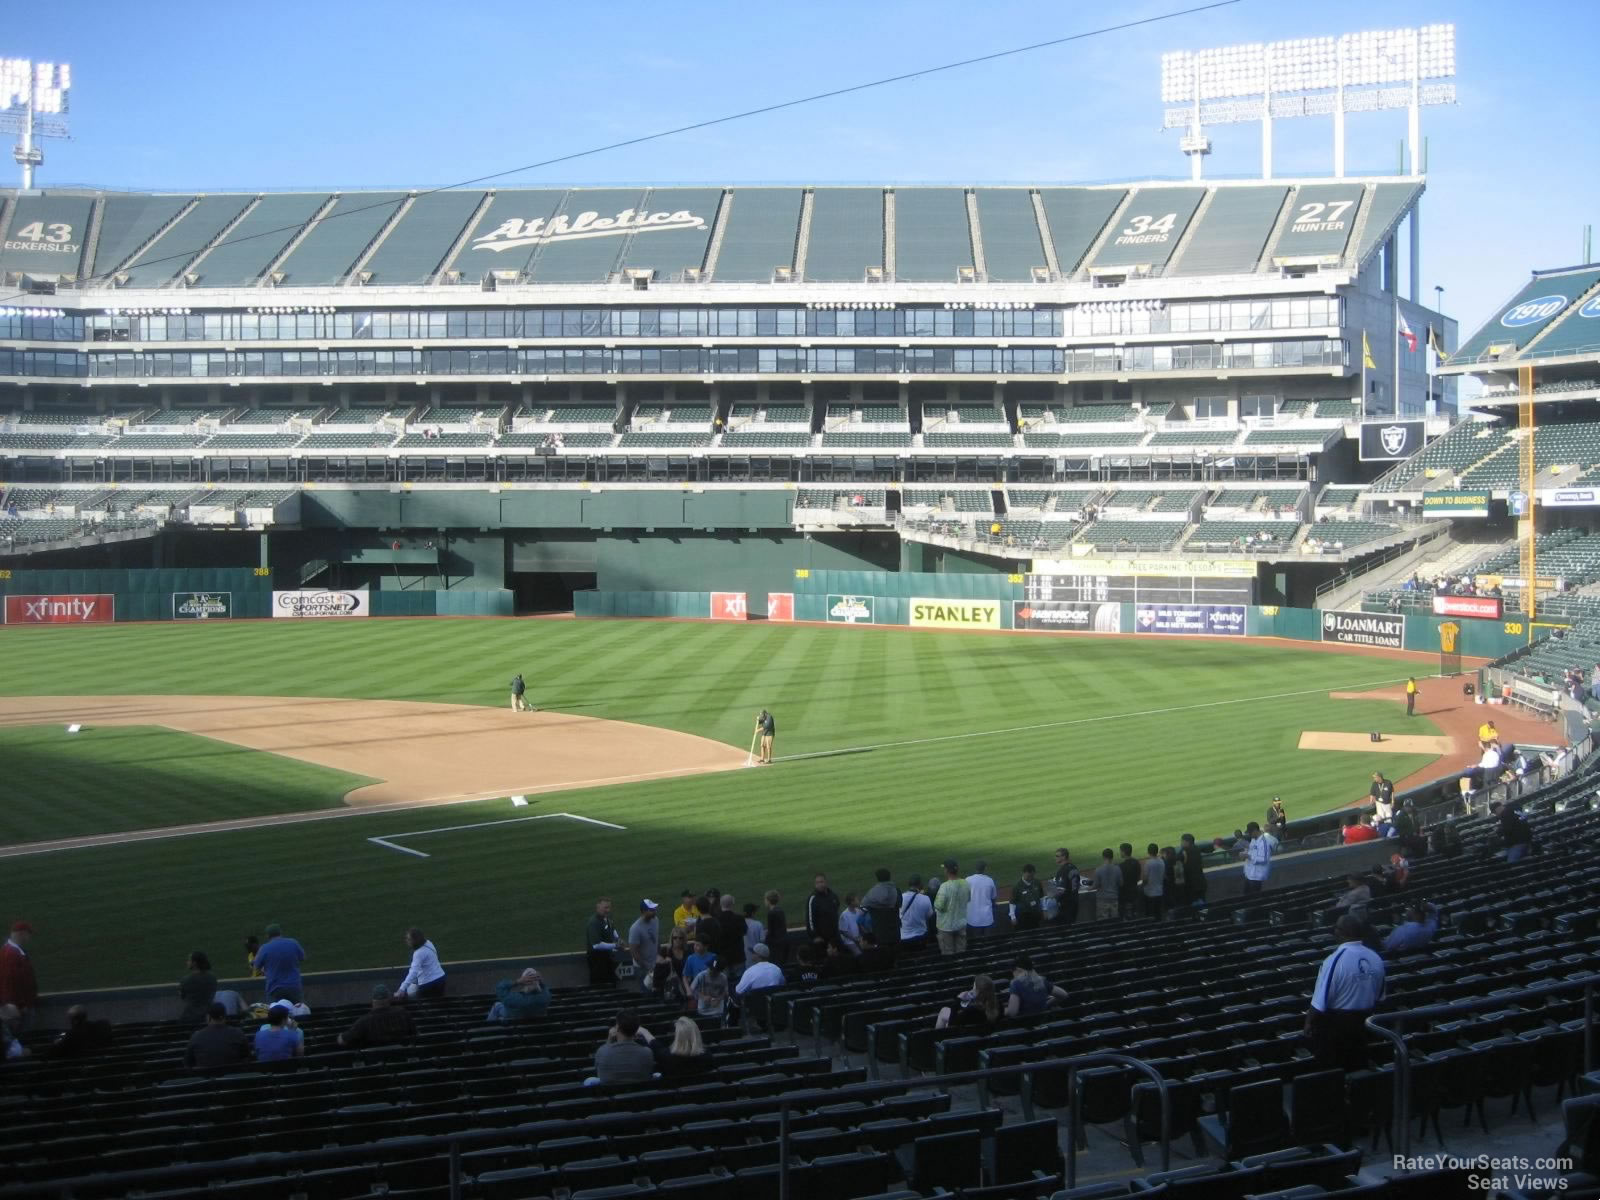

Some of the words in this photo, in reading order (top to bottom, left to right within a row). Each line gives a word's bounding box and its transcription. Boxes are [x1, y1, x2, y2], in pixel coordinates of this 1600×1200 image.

[1293, 201, 1354, 223] 27
[472, 208, 705, 250] Athletics
[1123, 213, 1177, 235] 34
[1291, 221, 1345, 233] HUNTER
[18, 222, 72, 242] 43
[1114, 233, 1169, 246] FINGERS
[4, 241, 80, 253] ECKERSLEY
[1509, 301, 1561, 319] 1910
[1424, 496, 1443, 505] DOWN
[1444, 496, 1453, 504] TO
[1454, 495, 1486, 505] BUSINESS
[254, 568, 269, 576] 388
[26, 598, 95, 620] xfinity
[914, 605, 994, 622] STANLEY
[1209, 612, 1243, 624] xfinity
[1504, 623, 1521, 634] 330
[1337, 632, 1353, 641] CAR
[1354, 634, 1374, 644] TITLE
[1375, 636, 1399, 646] LOANS
